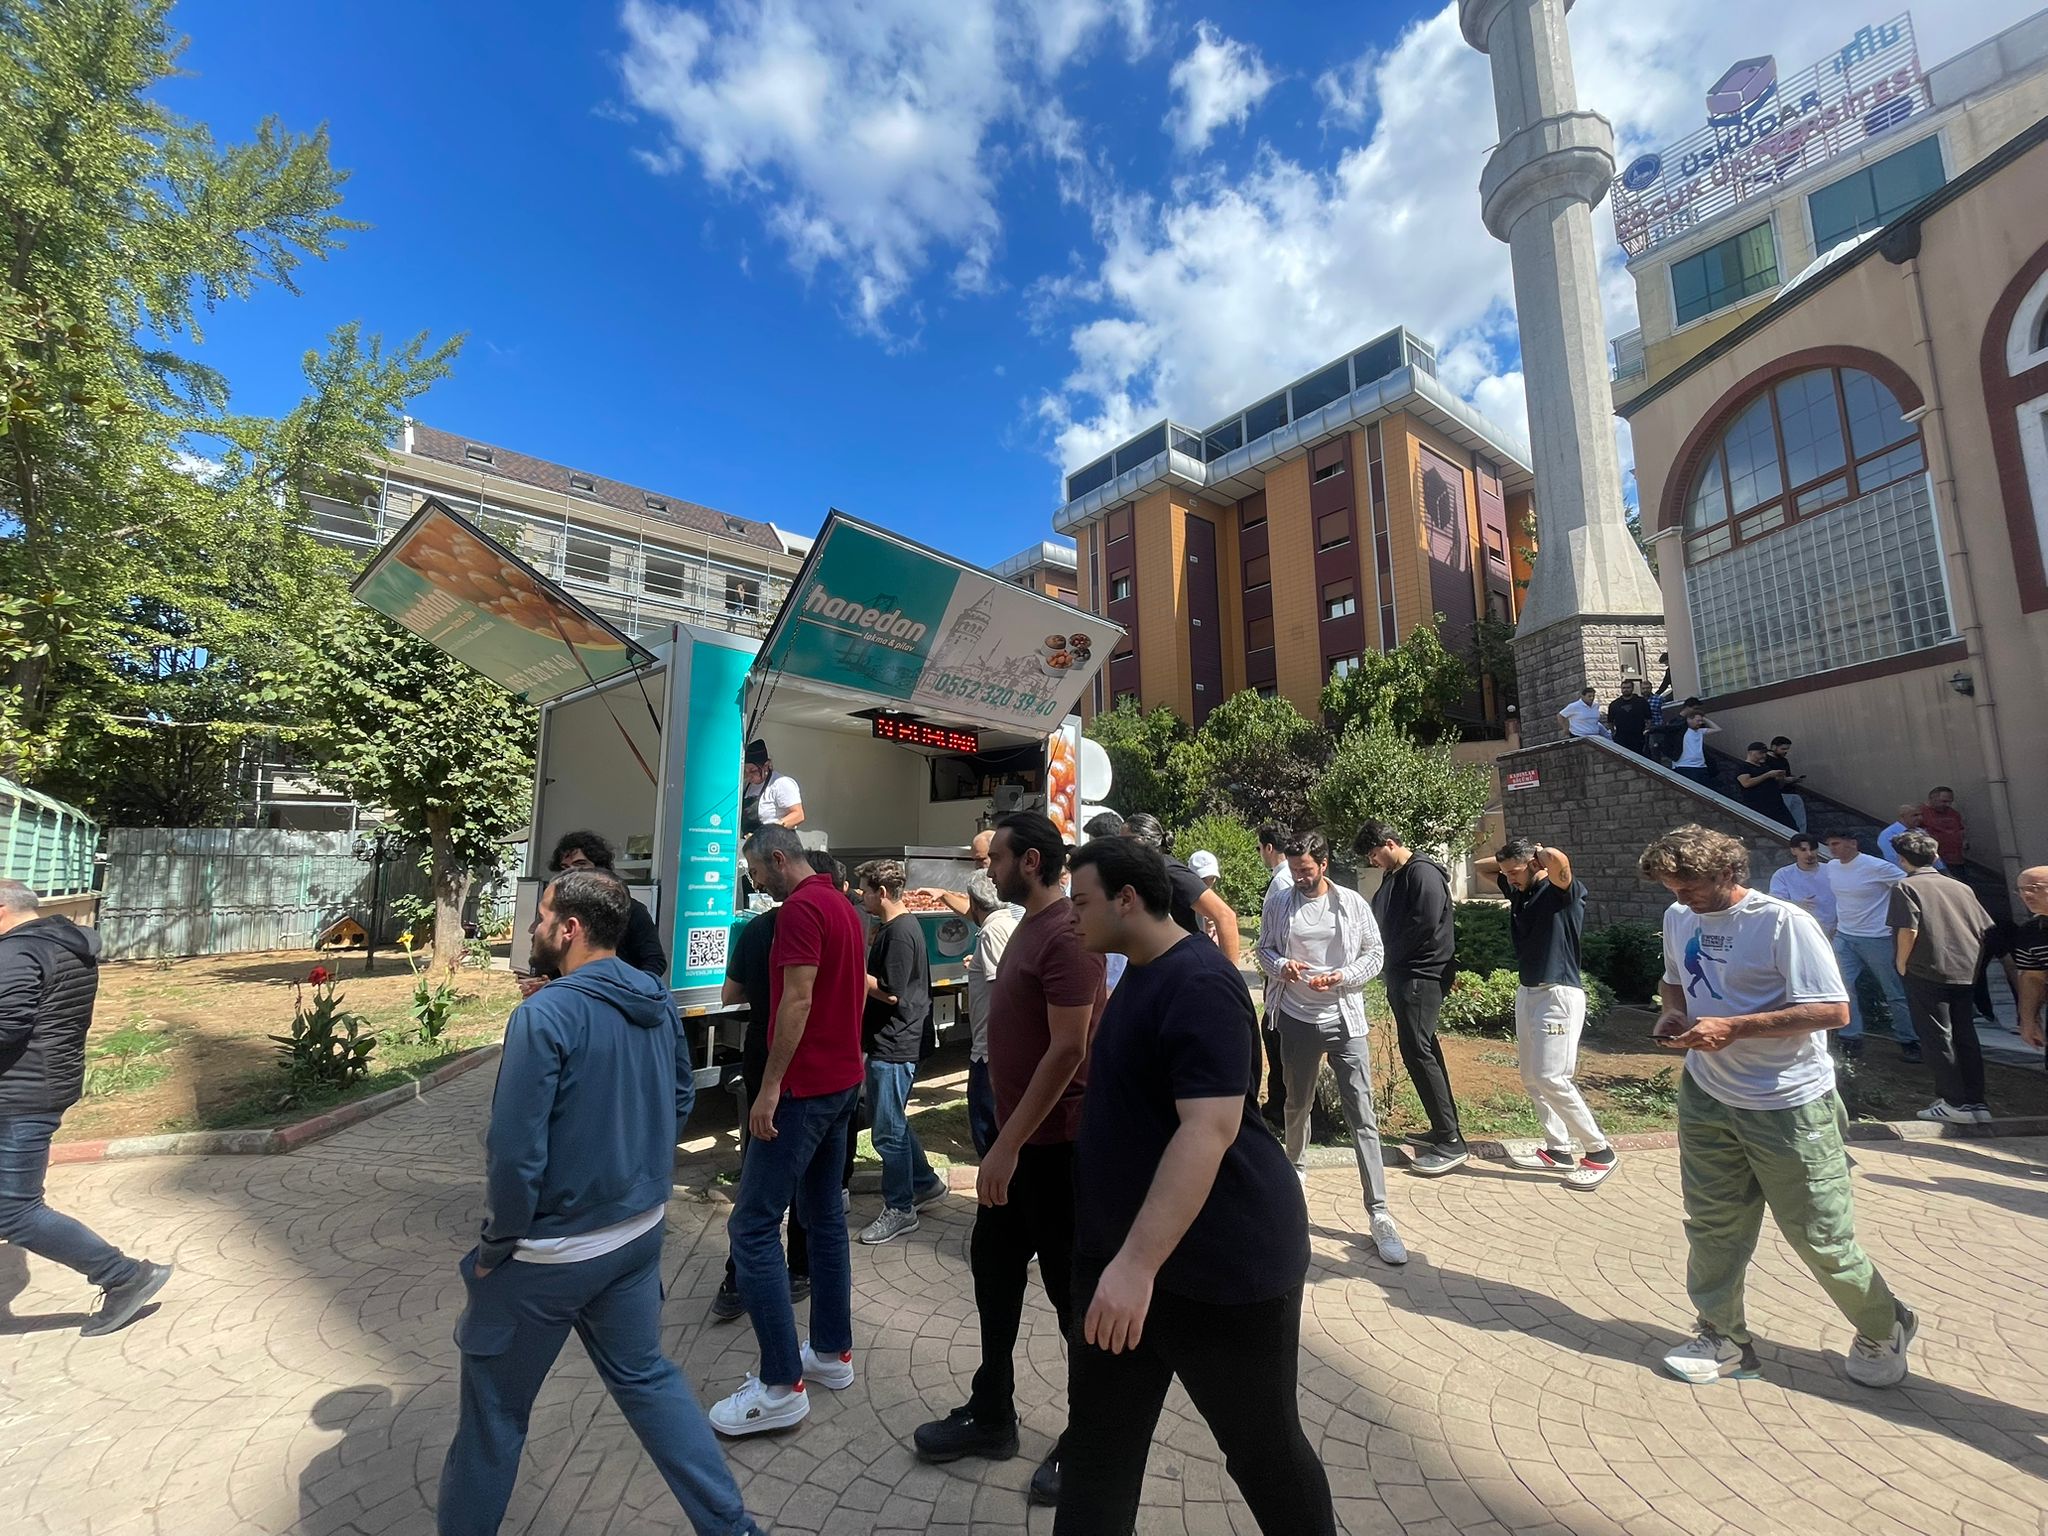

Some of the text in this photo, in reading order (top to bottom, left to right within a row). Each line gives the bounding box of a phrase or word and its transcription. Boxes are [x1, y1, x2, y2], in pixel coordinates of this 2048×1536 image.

[1681, 90, 1821, 177] ÜSKÜDAR
[804, 584, 927, 642] hanedan
[863, 632, 888, 645] lokma
[934, 673, 1058, 716] 0552 320 39 40
[1547, 1023, 1565, 1036] LA
